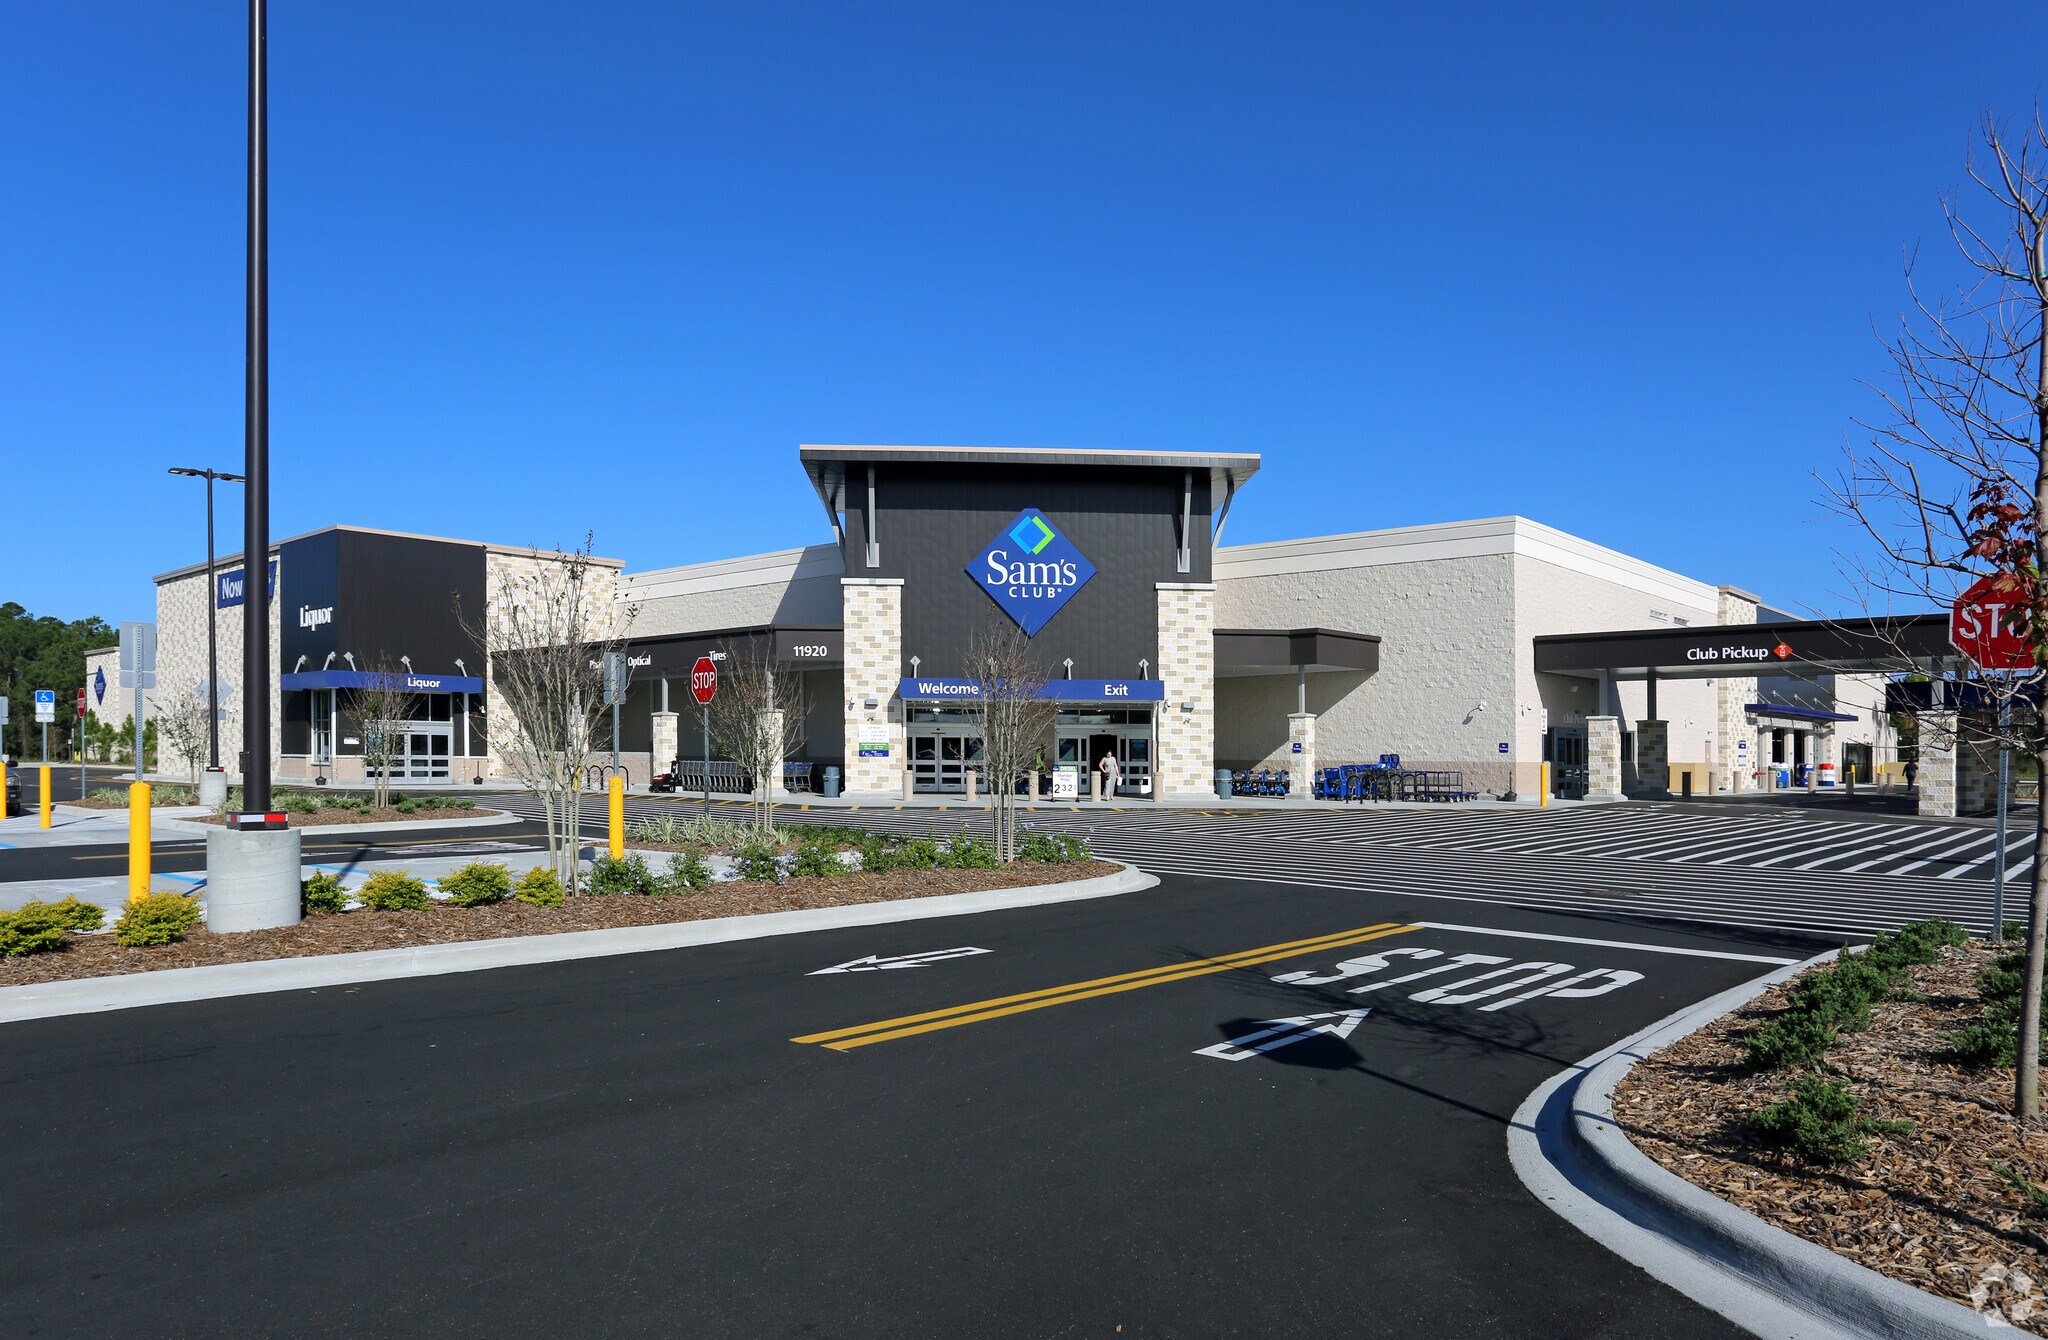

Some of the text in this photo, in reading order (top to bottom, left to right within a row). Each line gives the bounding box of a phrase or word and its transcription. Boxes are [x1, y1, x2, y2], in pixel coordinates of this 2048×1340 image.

[987, 550, 1077, 586] Sam's
[222, 577, 244, 600] Now
[300, 604, 333, 632] Liquor
[1959, 603, 2033, 638] STO
[709, 651, 727, 662] Tires
[793, 645, 828, 657] 11920
[1686, 646, 1769, 660] Club Pickup
[627, 655, 651, 668] Optical
[407, 677, 441, 689] Liquor
[693, 672, 715, 690] STOP
[919, 682, 979, 695] Welcome
[1104, 684, 1129, 696] Exit
[1270, 948, 1646, 1012] STOP
